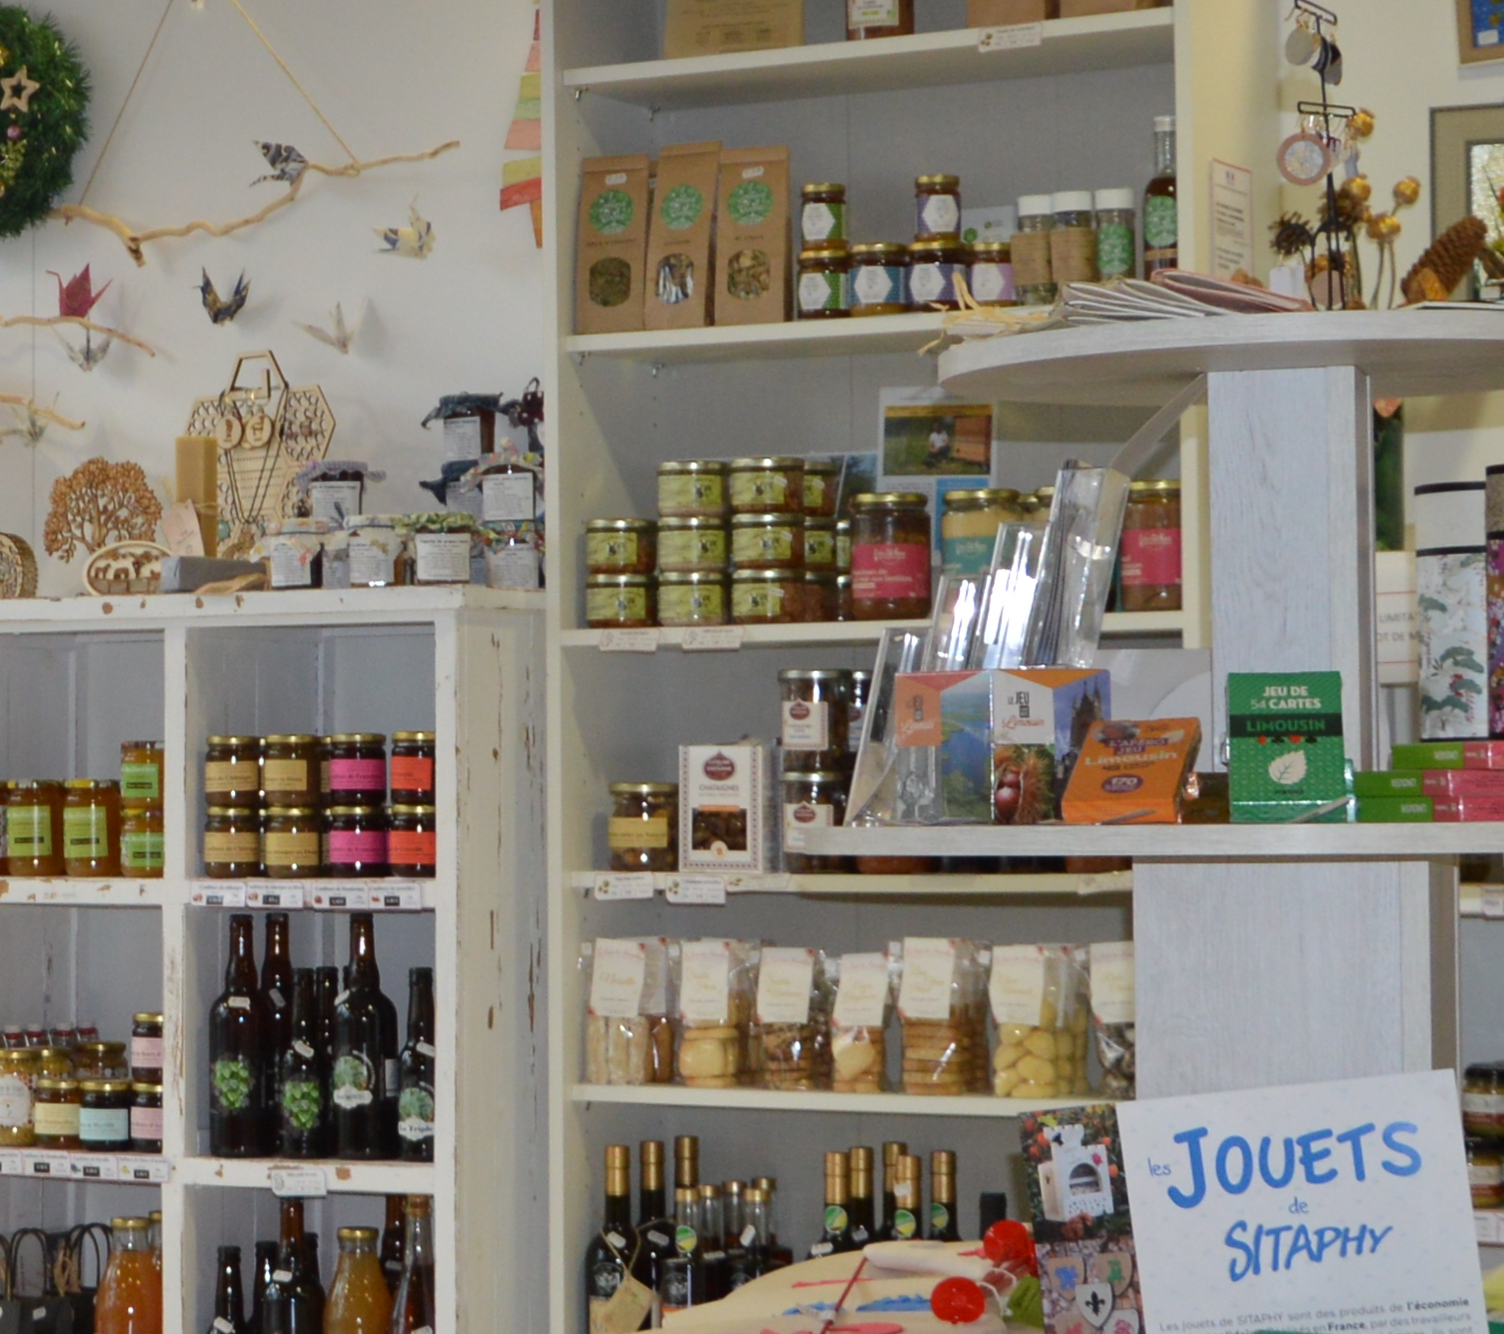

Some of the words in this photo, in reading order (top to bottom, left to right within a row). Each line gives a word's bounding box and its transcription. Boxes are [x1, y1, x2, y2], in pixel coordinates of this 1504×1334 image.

[1262, 685, 1288, 697] JEU
[1289, 685, 1309, 697] DE
[1250, 699, 1267, 710] 54
[1269, 698, 1322, 710] CARTES
[1246, 719, 1326, 732] LIMOUSIN
[1117, 746, 1143, 755] JEU
[1084, 751, 1178, 766] Limousin
[1110, 776, 1138, 786] 170
[1147, 1156, 1172, 1179] les
[1167, 1120, 1423, 1209] JOUETS
[1288, 1196, 1310, 1216] de
[1223, 1219, 1393, 1282] SITAPHY
[1159, 1322, 1179, 1333] Les
[1181, 1318, 1216, 1333] jouets
[1219, 1316, 1234, 1327] de
[1236, 1312, 1284, 1326] SITAPHY
[1287, 1310, 1312, 1322] sont
[1315, 1307, 1336, 1319] des
[1338, 1303, 1385, 1321] produits
[1389, 1303, 1404, 1314] de
[1406, 1297, 1471, 1313] l'économie
[1370, 1318, 1389, 1331] par
[1389, 1316, 1408, 1328] des
